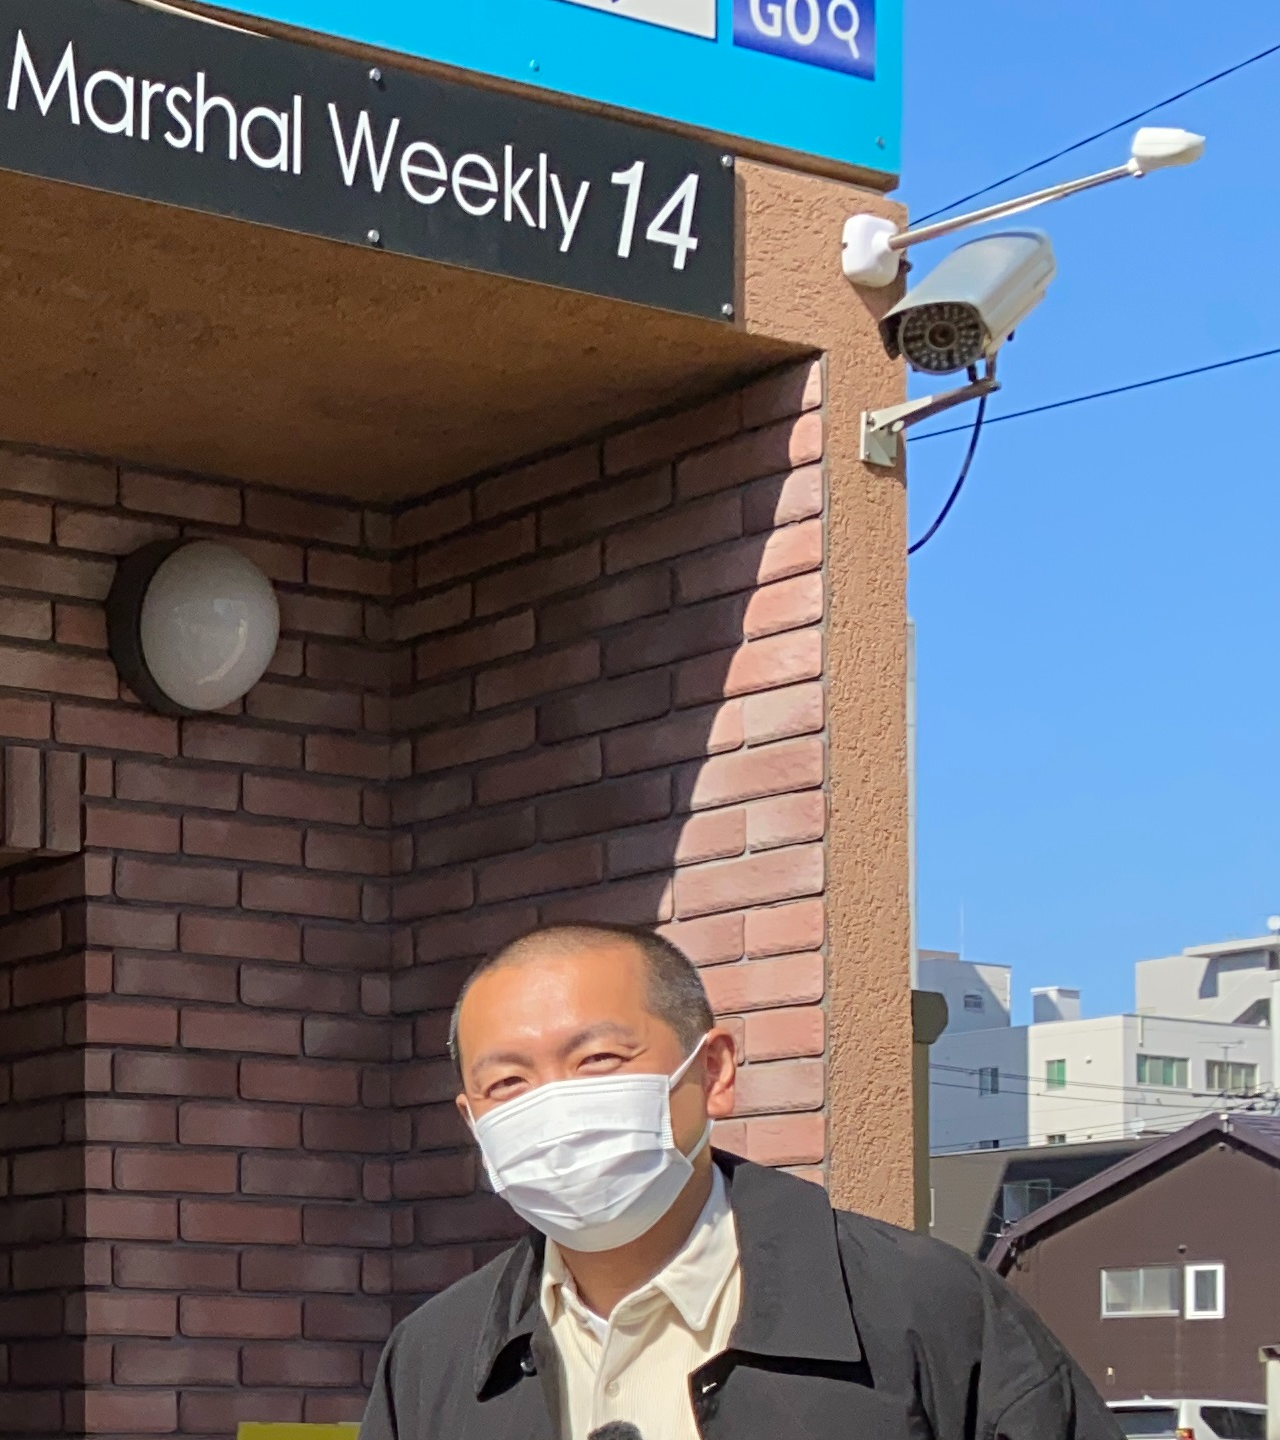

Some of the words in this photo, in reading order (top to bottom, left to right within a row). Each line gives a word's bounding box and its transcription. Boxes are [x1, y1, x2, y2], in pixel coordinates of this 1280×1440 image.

[5, 29, 303, 176] Marshal
[327, 101, 591, 253] Weekly
[609, 159, 699, 271] 14
